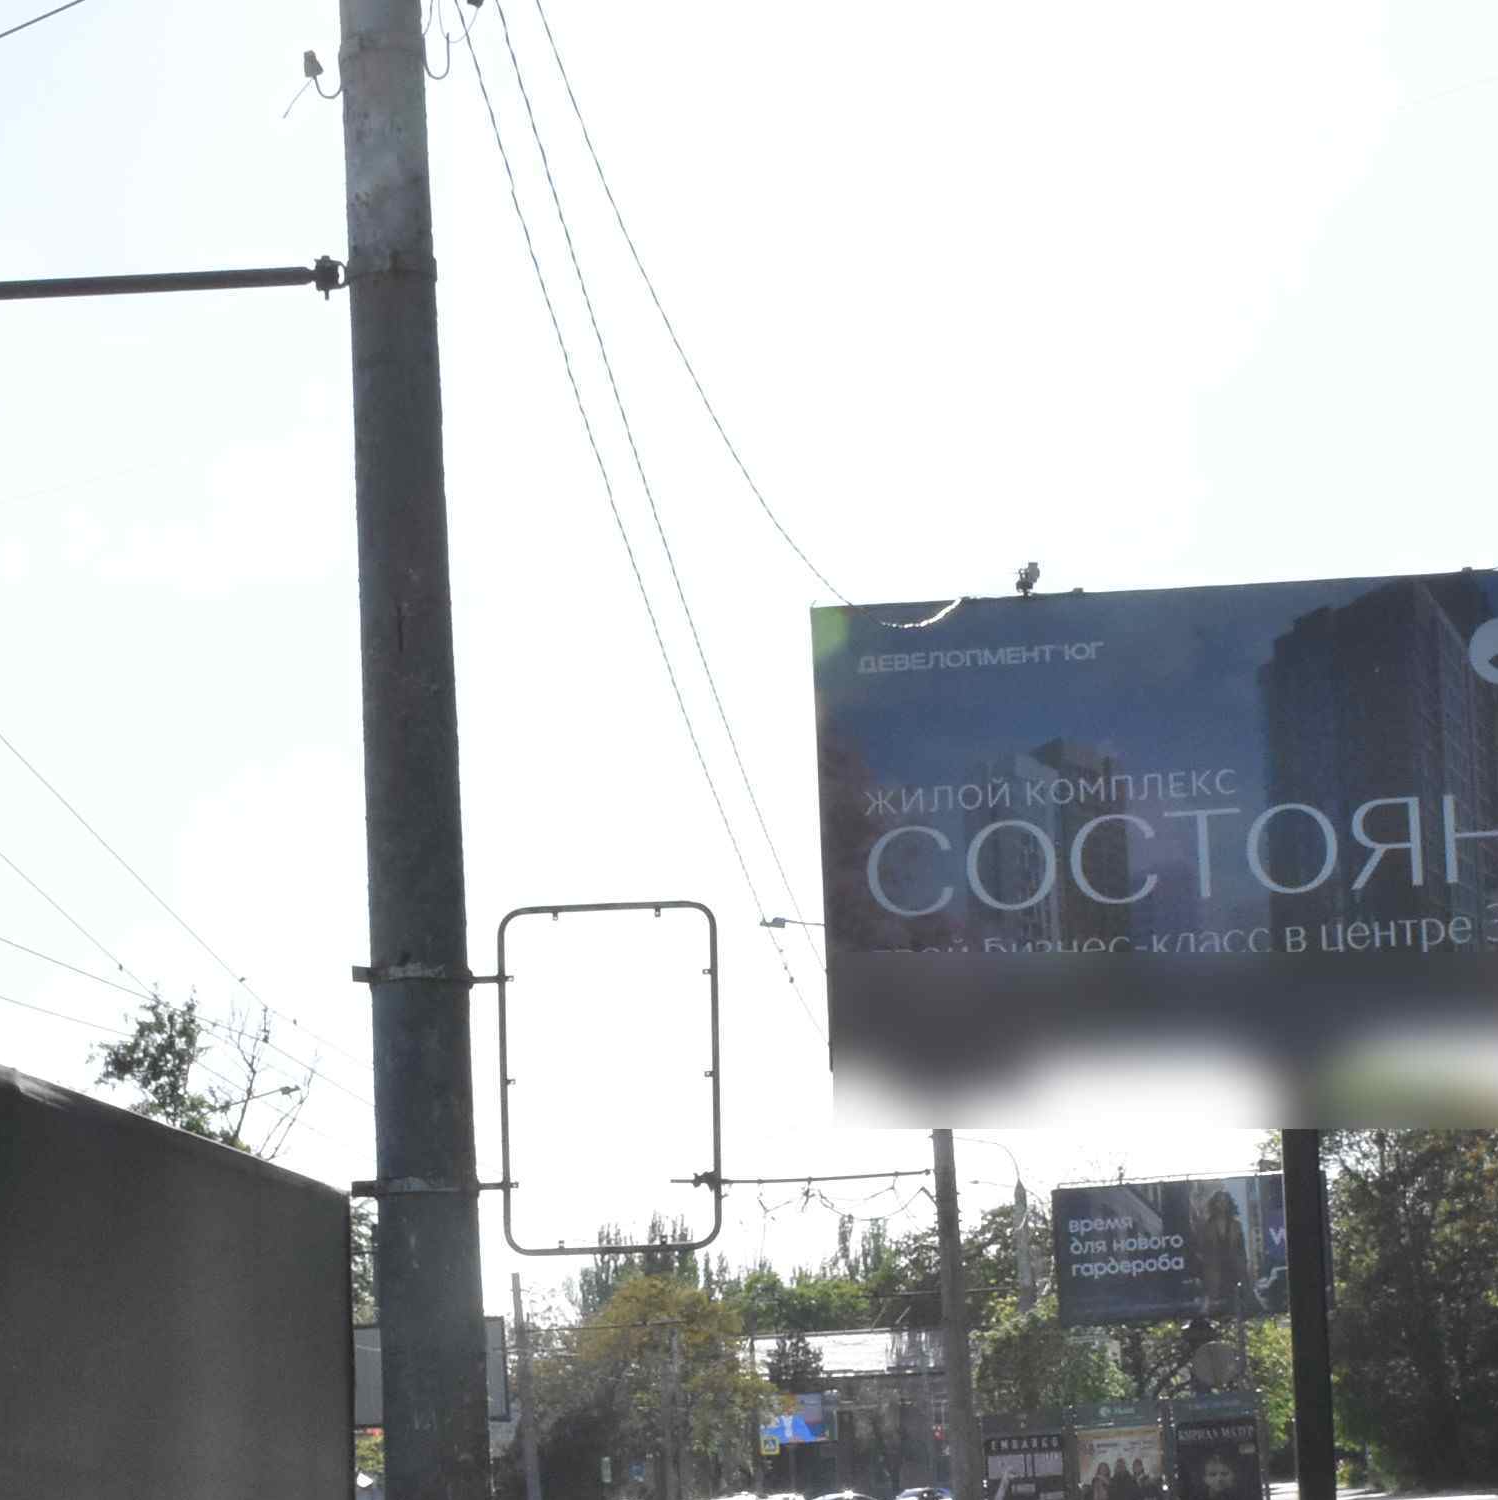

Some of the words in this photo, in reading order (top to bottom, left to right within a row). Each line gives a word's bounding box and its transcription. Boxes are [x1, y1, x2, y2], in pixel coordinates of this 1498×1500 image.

[864, 777, 1012, 818] ЖИЛОЙ
[1025, 768, 1237, 807] КОМПЛЕКС
[1284, 926, 1307, 953] в
[1320, 913, 1473, 953] центре
[1068, 1216, 1134, 1236] время
[1069, 1237, 1107, 1255] для
[1112, 1232, 1184, 1252] нового
[1071, 1253, 1185, 1280] гардероба
